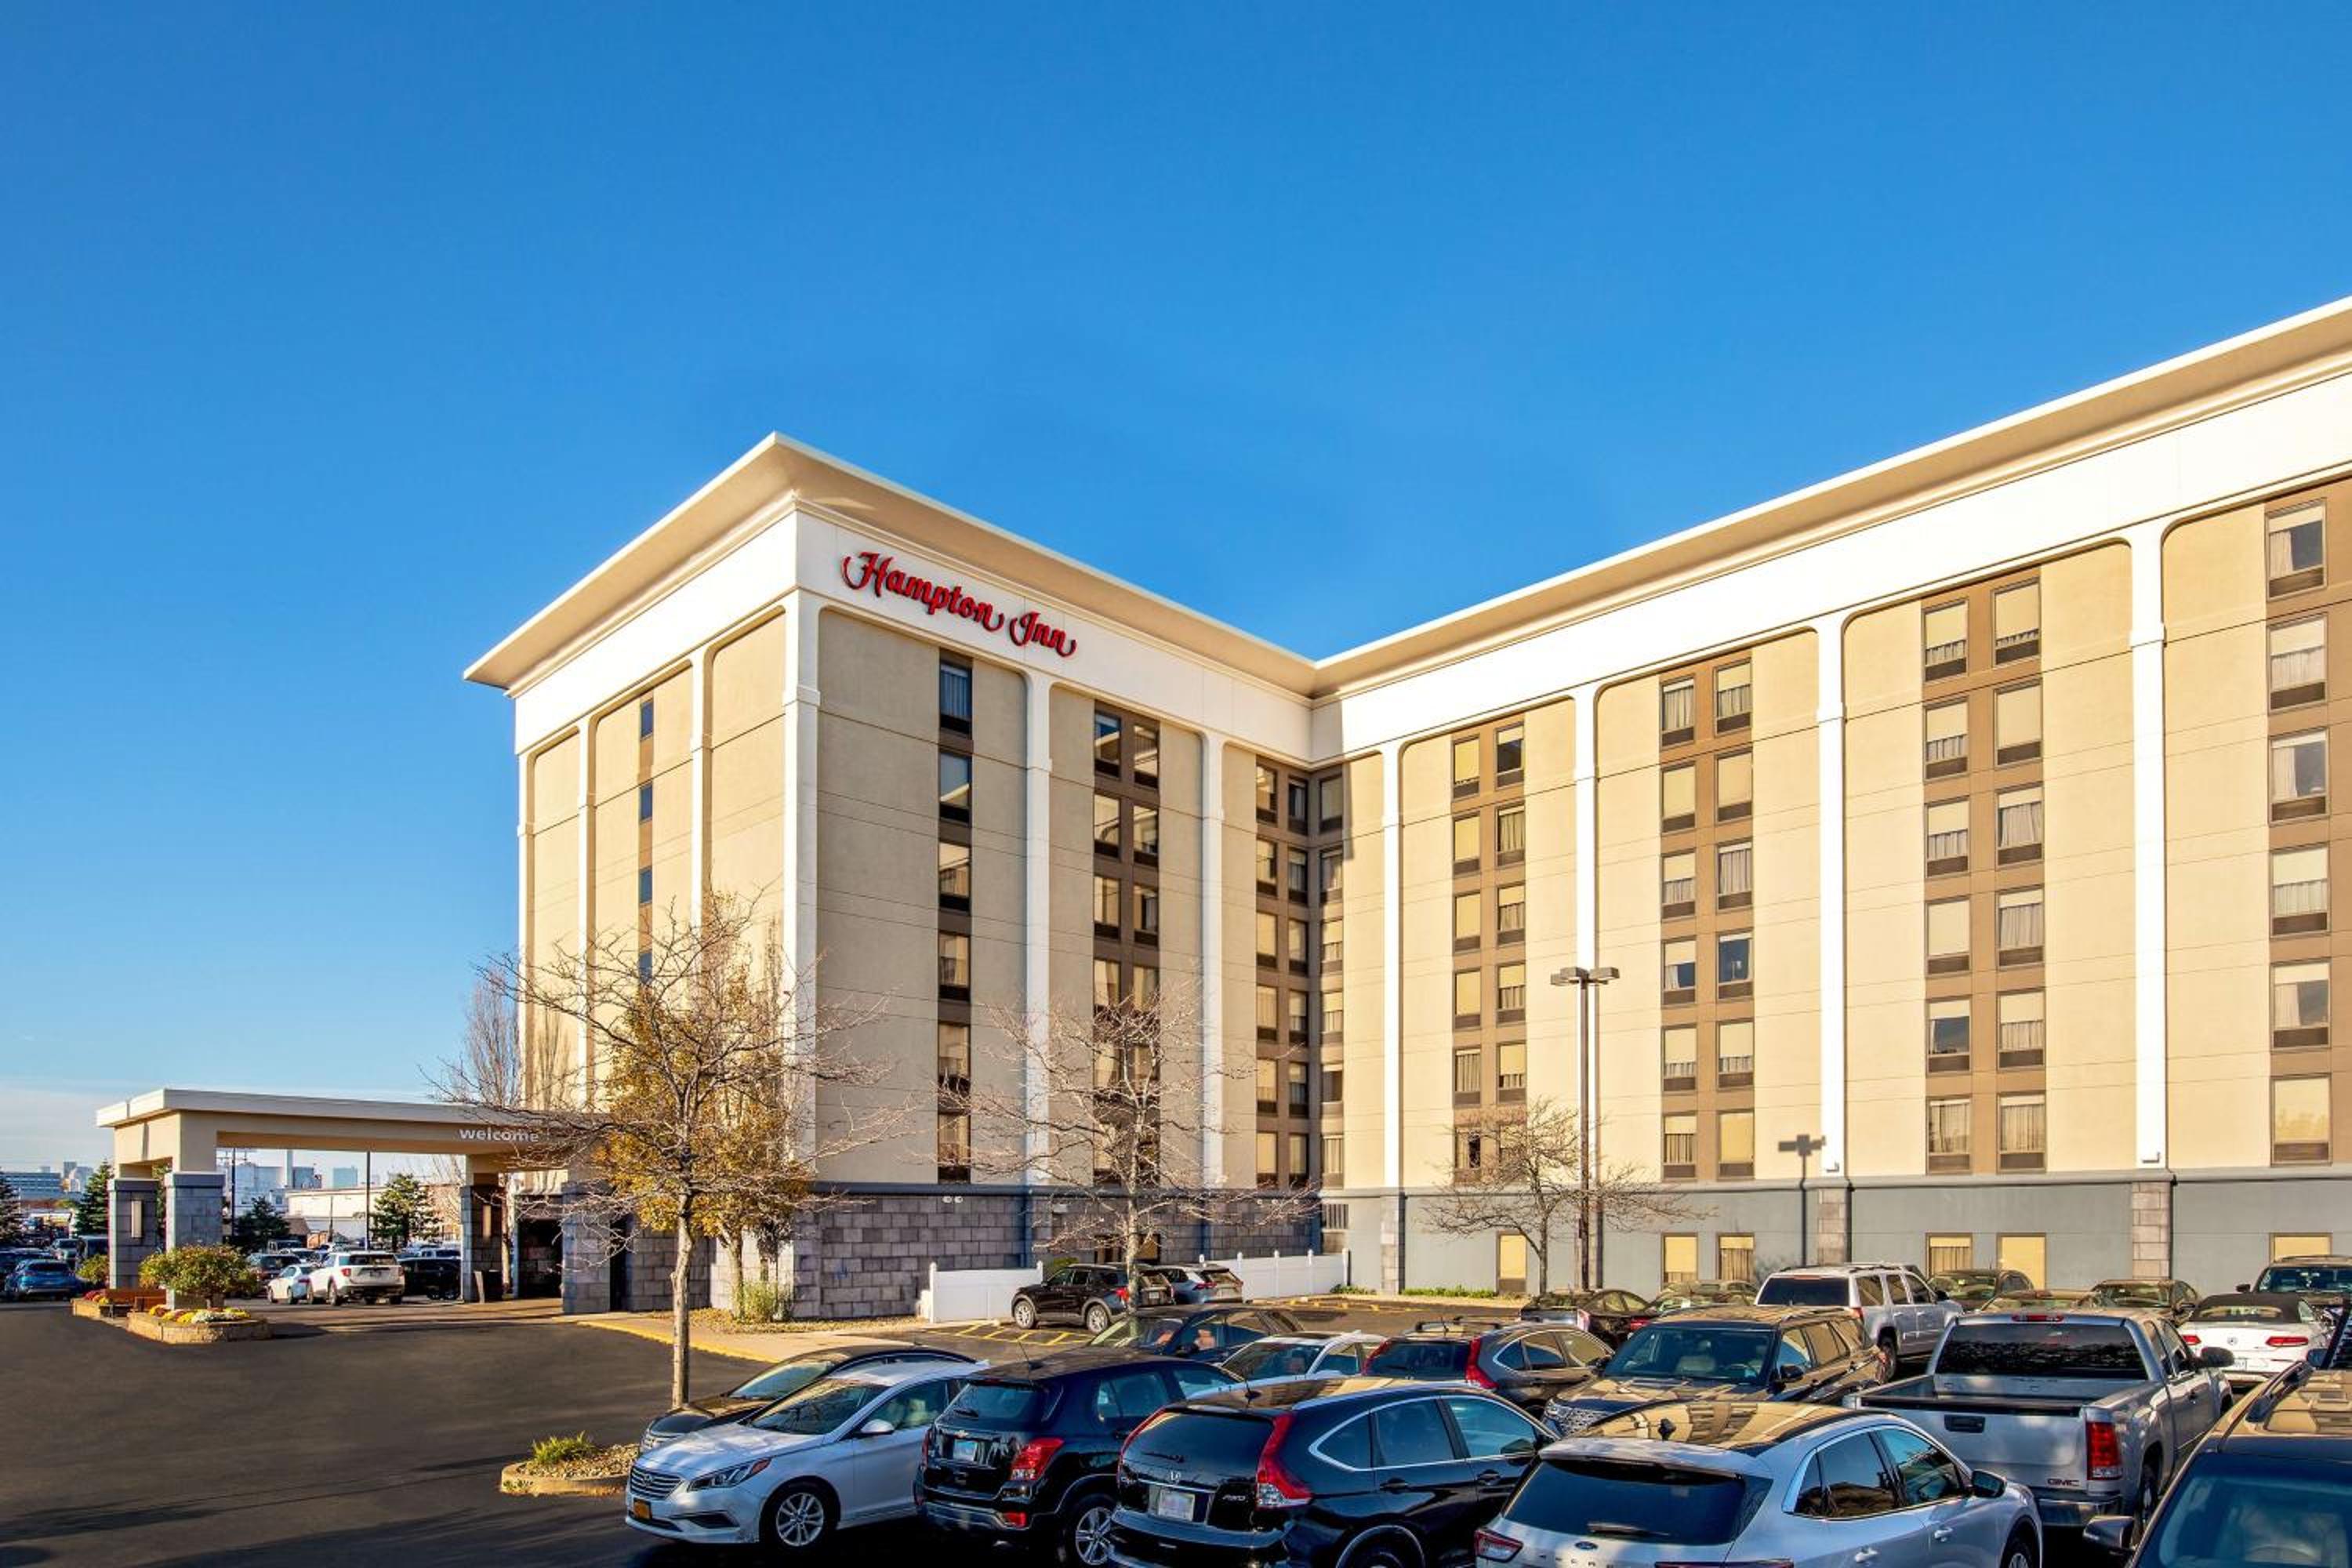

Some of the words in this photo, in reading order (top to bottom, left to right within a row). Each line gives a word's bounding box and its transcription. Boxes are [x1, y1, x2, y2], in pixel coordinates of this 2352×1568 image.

[841, 551, 1004, 632] Hampton
[1009, 611, 1077, 657] Inn
[459, 1127, 539, 1142] welcome
[2046, 1478, 2080, 1487] GMC
